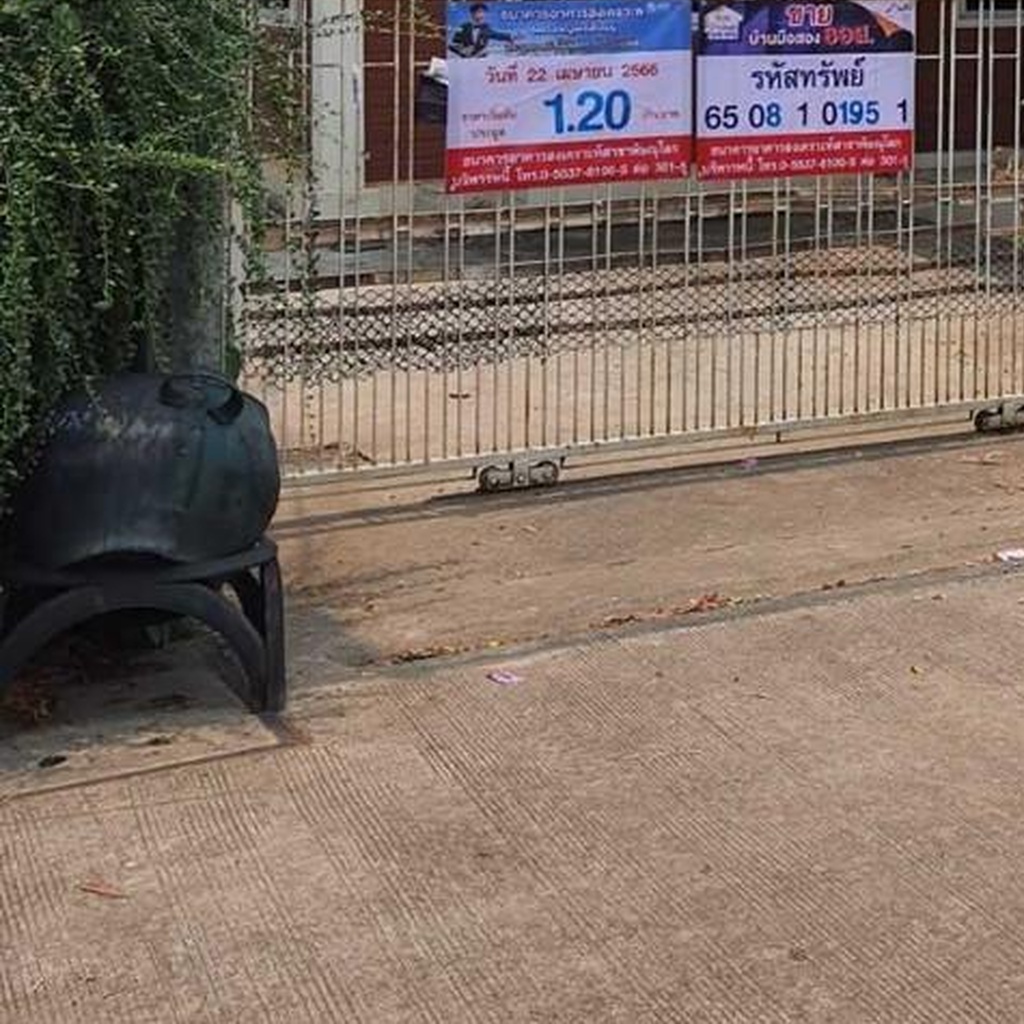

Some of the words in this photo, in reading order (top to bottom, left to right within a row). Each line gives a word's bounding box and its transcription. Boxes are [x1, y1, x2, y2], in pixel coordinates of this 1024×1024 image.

[786, 4, 834, 27] ขาย
[485, 63, 519, 84] วันที่
[526, 68, 547, 83] 22
[556, 65, 614, 81] เมษายน
[621, 62, 659, 79] 2566
[751, 57, 867, 91] รหัสทรัพย์
[543, 90, 632, 135] 1.20
[704, 105, 739, 130] 65
[748, 103, 782, 129] 08
[797, 102, 809, 127] 1
[822, 100, 880, 126] 0195
[896, 99, 908, 124] 1
